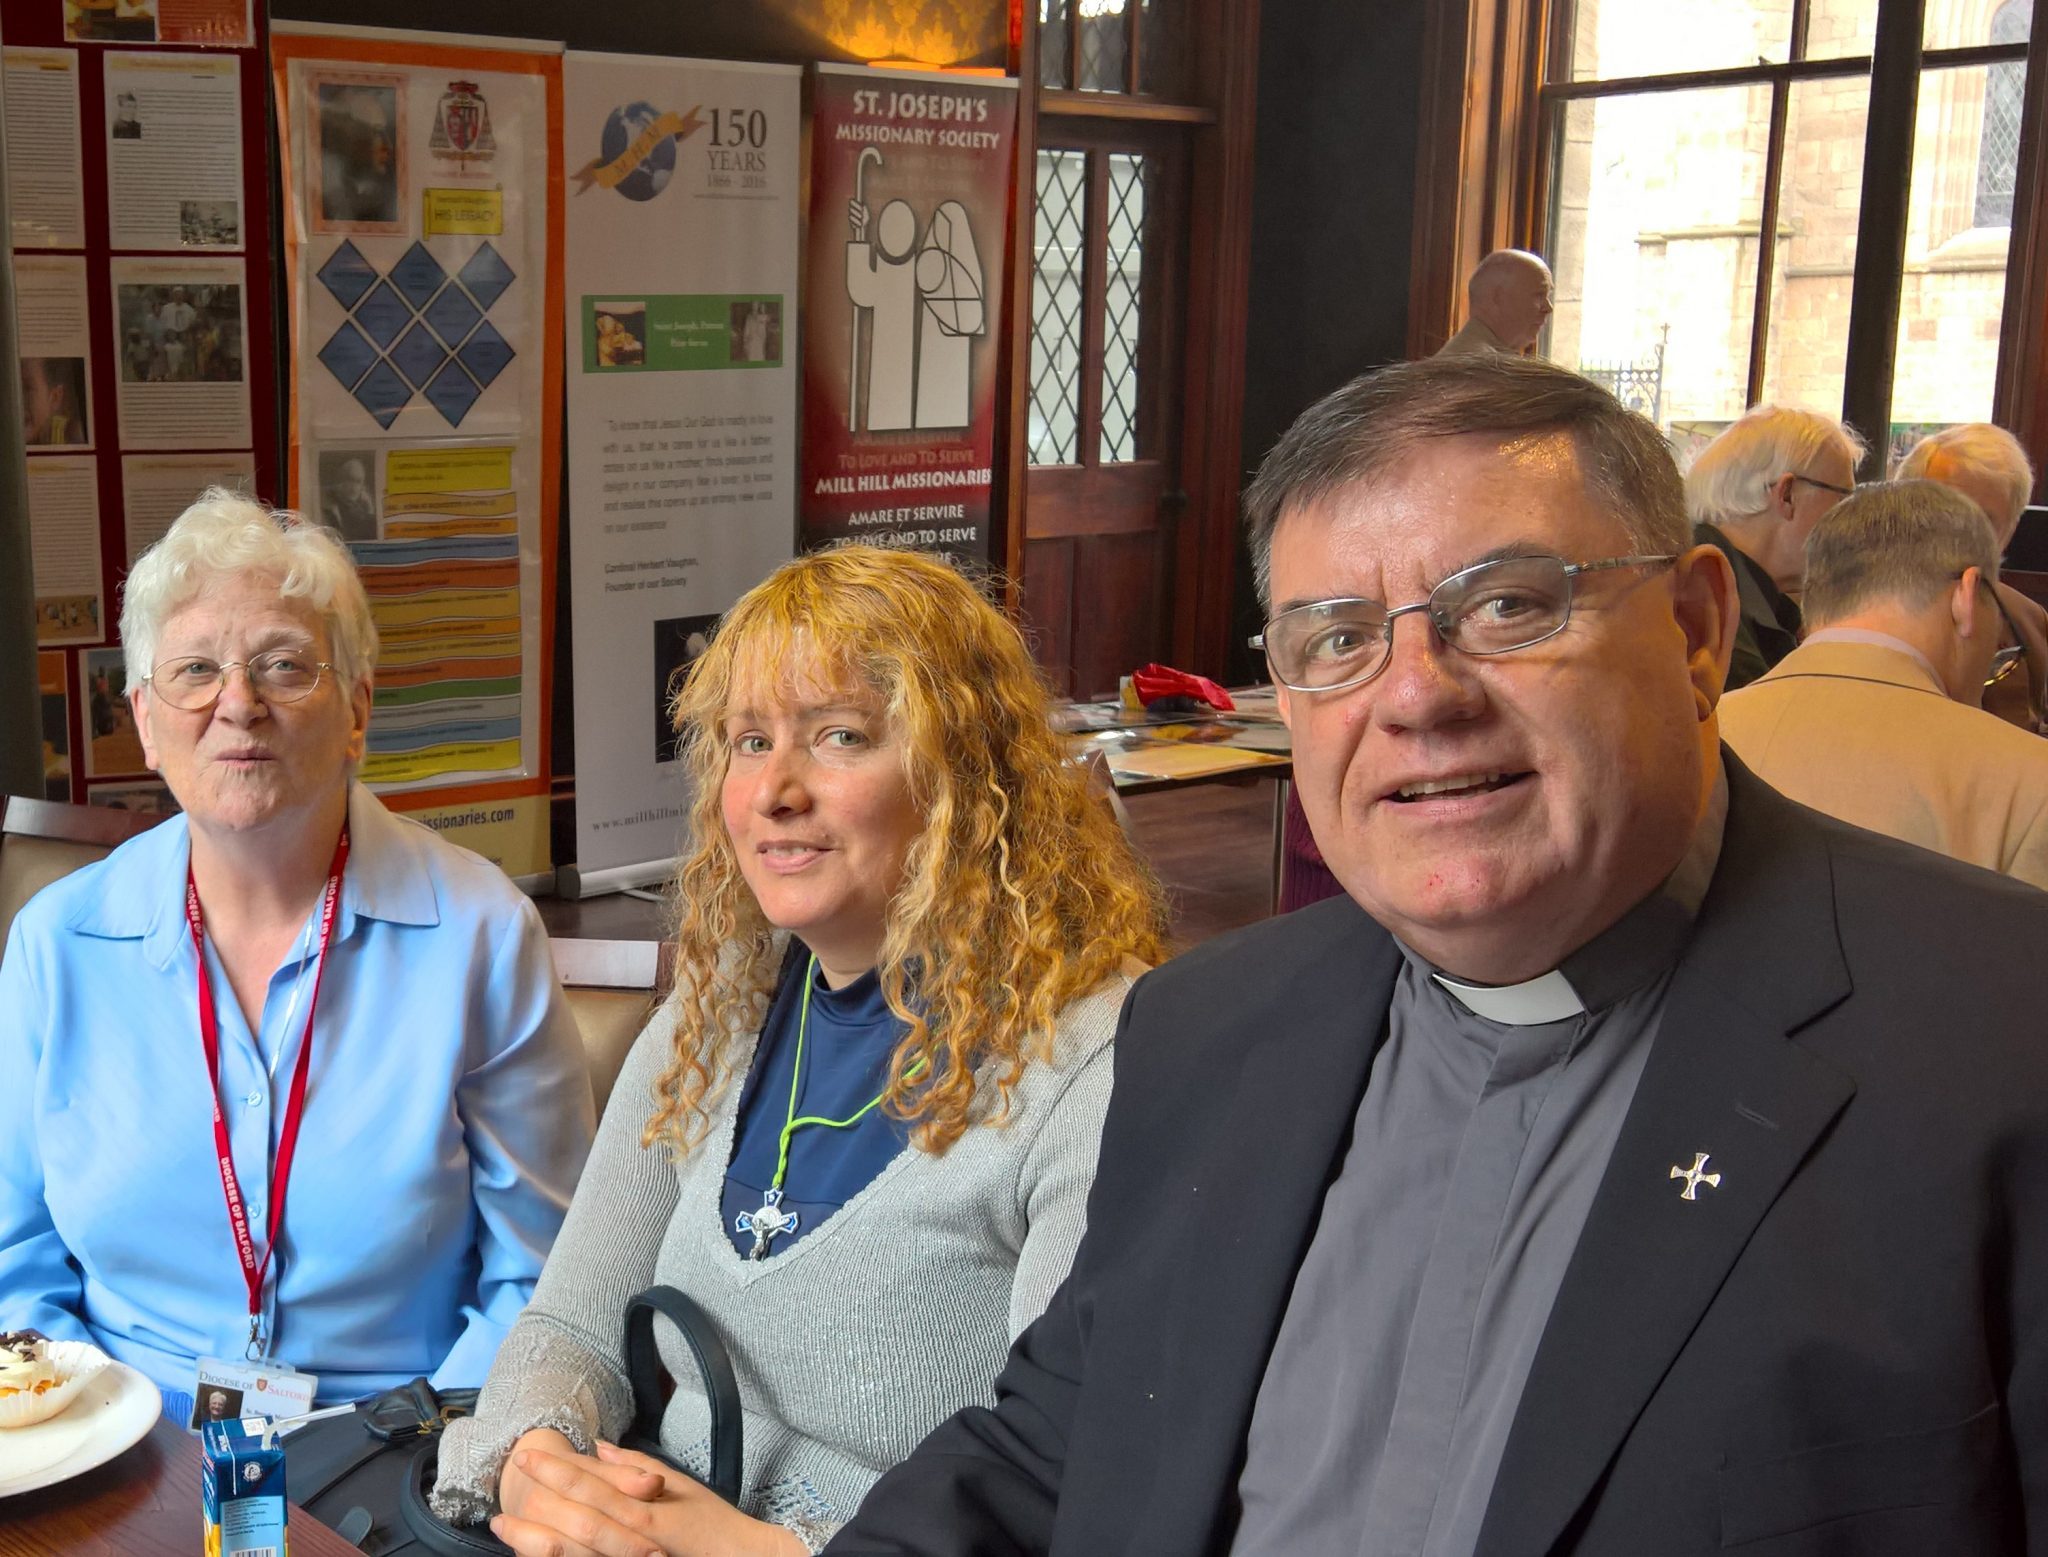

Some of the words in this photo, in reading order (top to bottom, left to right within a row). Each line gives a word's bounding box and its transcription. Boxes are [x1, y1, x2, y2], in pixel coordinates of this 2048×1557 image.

[853, 89, 883, 115] ST.
[888, 92, 988, 122] JOSEPH'S
[708, 107, 768, 149] 150
[836, 124, 935, 145] MISSIONARY
[938, 129, 1000, 149] SOCIETY
[707, 150, 767, 172] YEARS
[840, 454, 857, 469] TO
[858, 453, 888, 469] LOVE
[888, 452, 917, 467] AND
[918, 450, 937, 465] TO
[938, 449, 975, 463] SERVE
[815, 477, 855, 494] MILL
[858, 474, 890, 492] HILL
[892, 468, 992, 490] MISSIONARIES
[848, 509, 893, 526] AMARE
[896, 507, 912, 521] ET
[913, 504, 965, 521] SERVIRE
[888, 531, 917, 546] AND
[918, 530, 937, 544] TO
[939, 527, 977, 543] SERVE
[604, 580, 636, 593] Founder
[637, 579, 646, 590] of
[661, 576, 687, 588] Society
[221, 1157, 239, 1204] DIOCESE
[231, 1204, 243, 1219] OF
[235, 1219, 255, 1269] SALFORD
[199, 1371, 241, 1388] DIOCESE
[241, 1381, 255, 1391] OF
